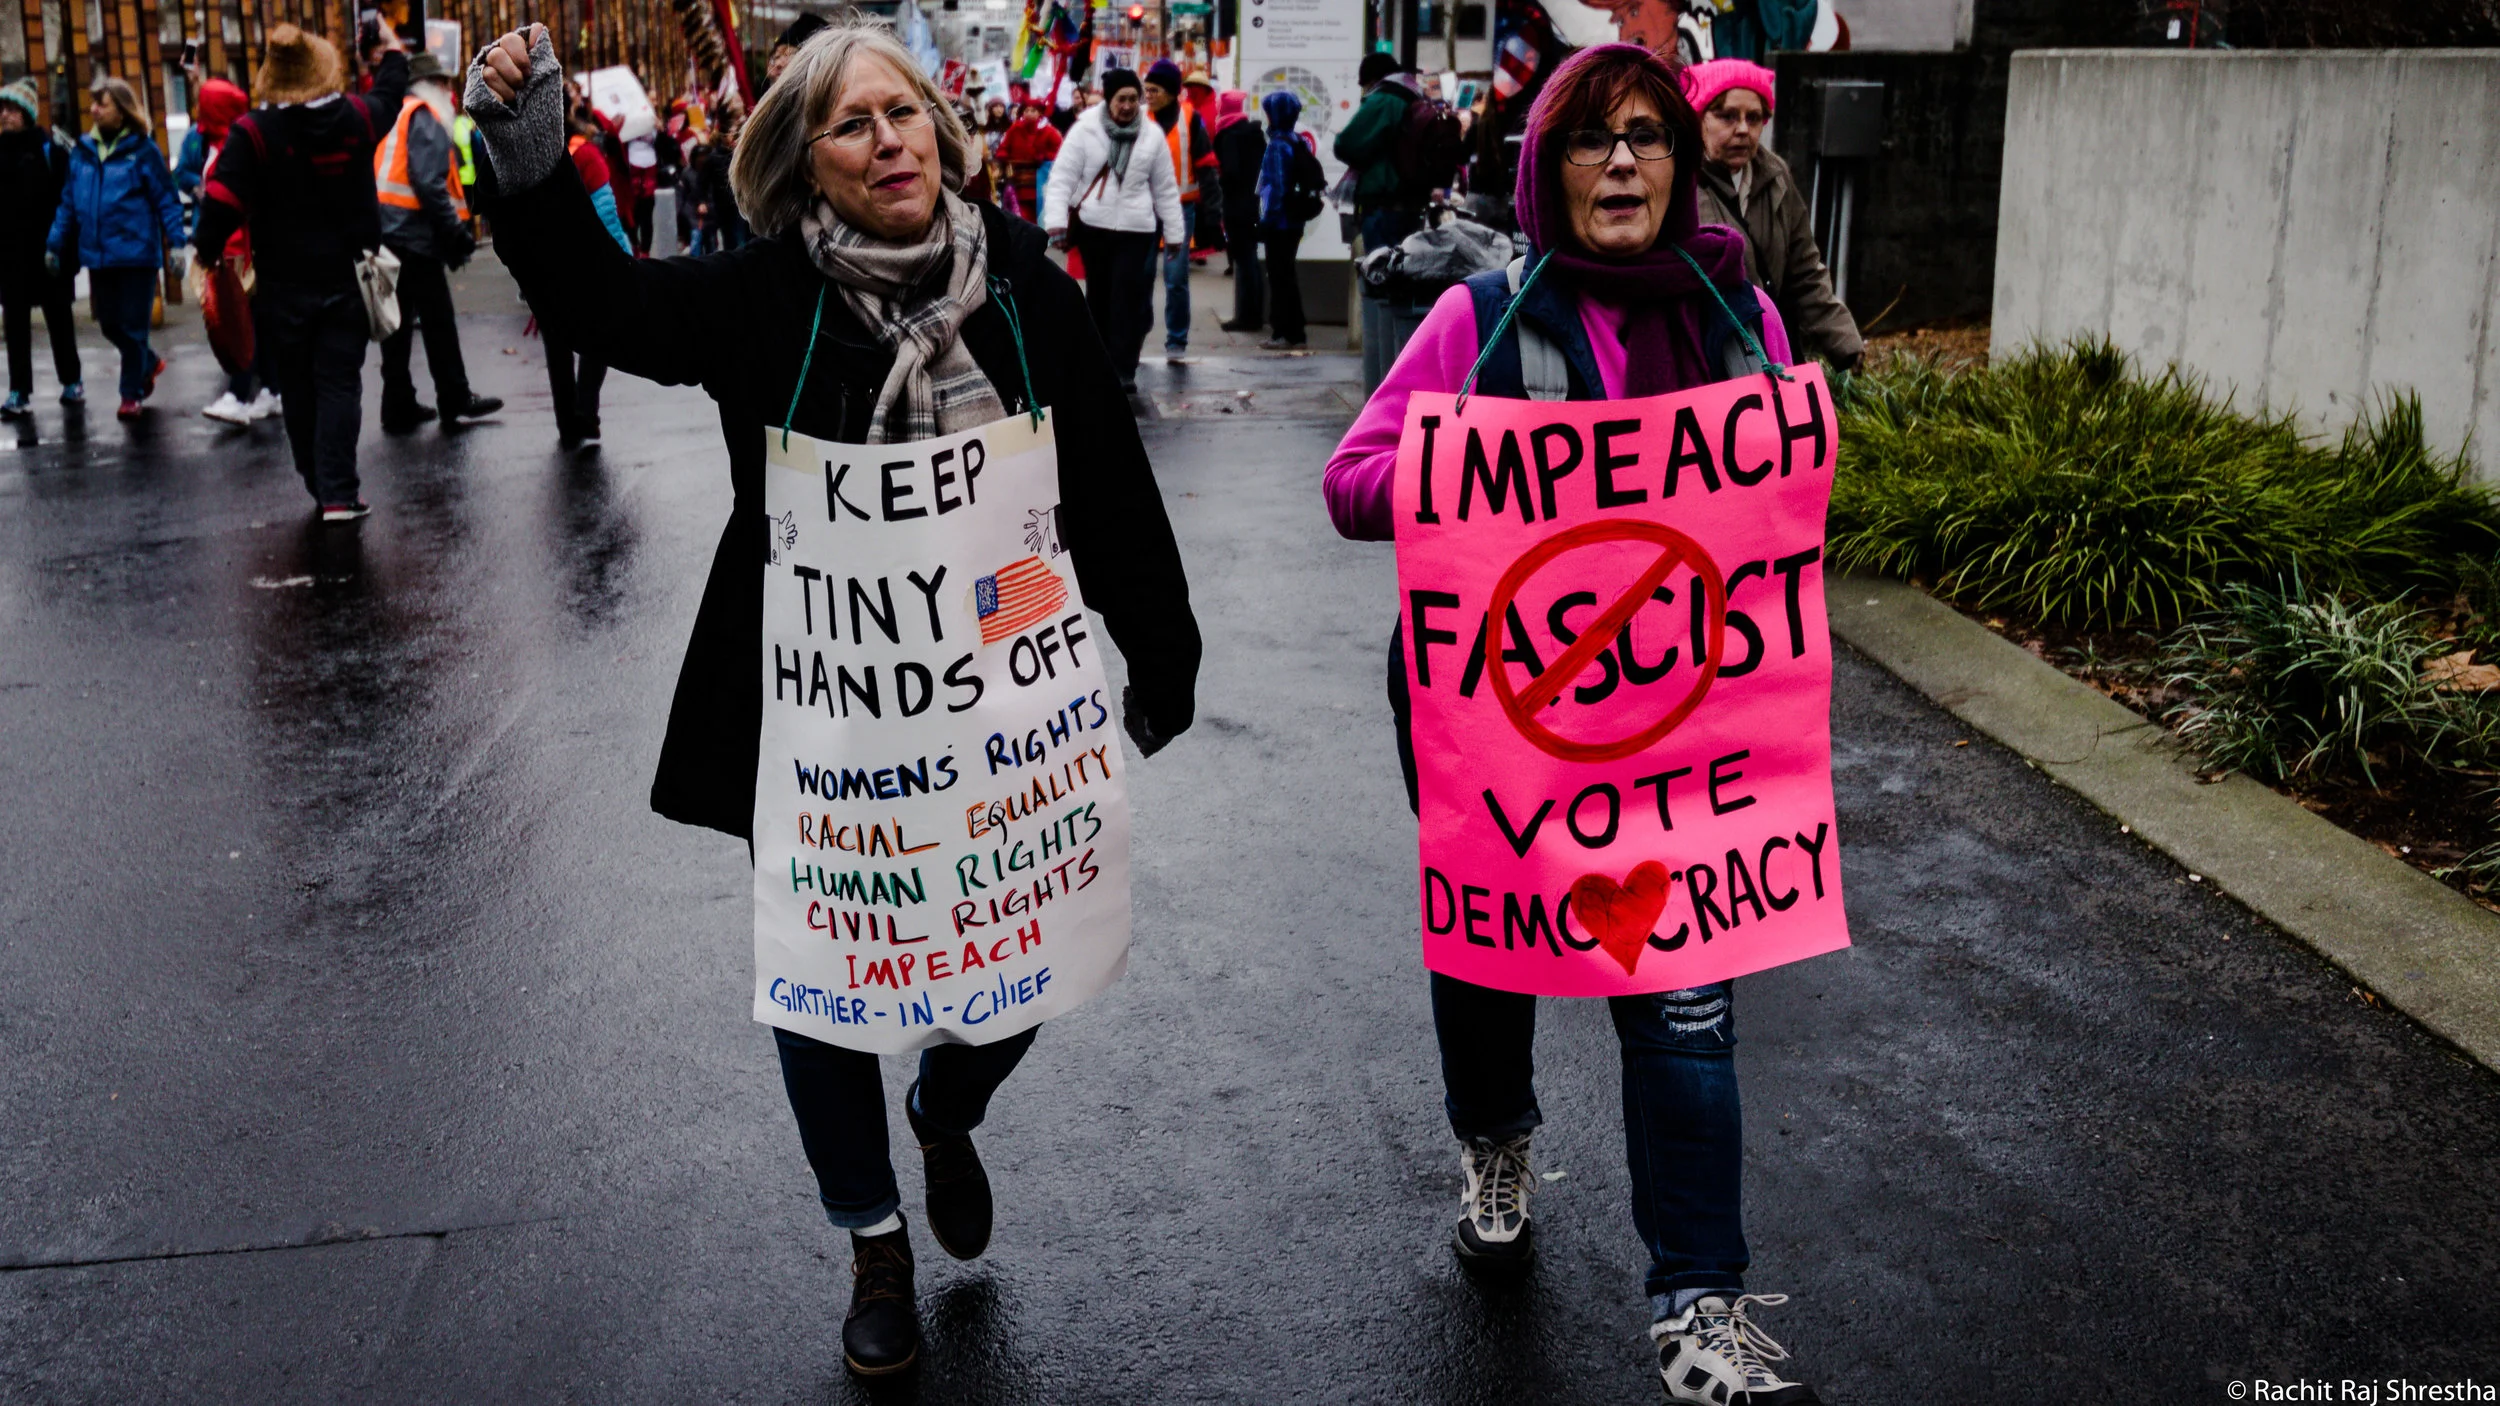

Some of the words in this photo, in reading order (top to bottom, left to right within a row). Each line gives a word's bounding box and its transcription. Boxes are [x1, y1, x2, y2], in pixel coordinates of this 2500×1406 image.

[825, 438, 986, 522] KEEP
[1415, 381, 1827, 525] IMPEACH
[794, 564, 947, 645] TINY
[1409, 546, 1820, 706] FASCIST
[775, 644, 984, 720] HANDS
[1009, 613, 1087, 687] OFF
[984, 689, 1108, 776] RIGHTS
[791, 856, 928, 908] HUMAN
[956, 801, 1103, 897] RIGHTS
[798, 812, 941, 858] RACIAL
[966, 744, 1113, 846] EQUALITY
[1482, 749, 1757, 859] VOTE
[807, 900, 930, 946] CIVIL
[951, 847, 1100, 938] RIGHTS
[845, 918, 1043, 990] IMPEACH
